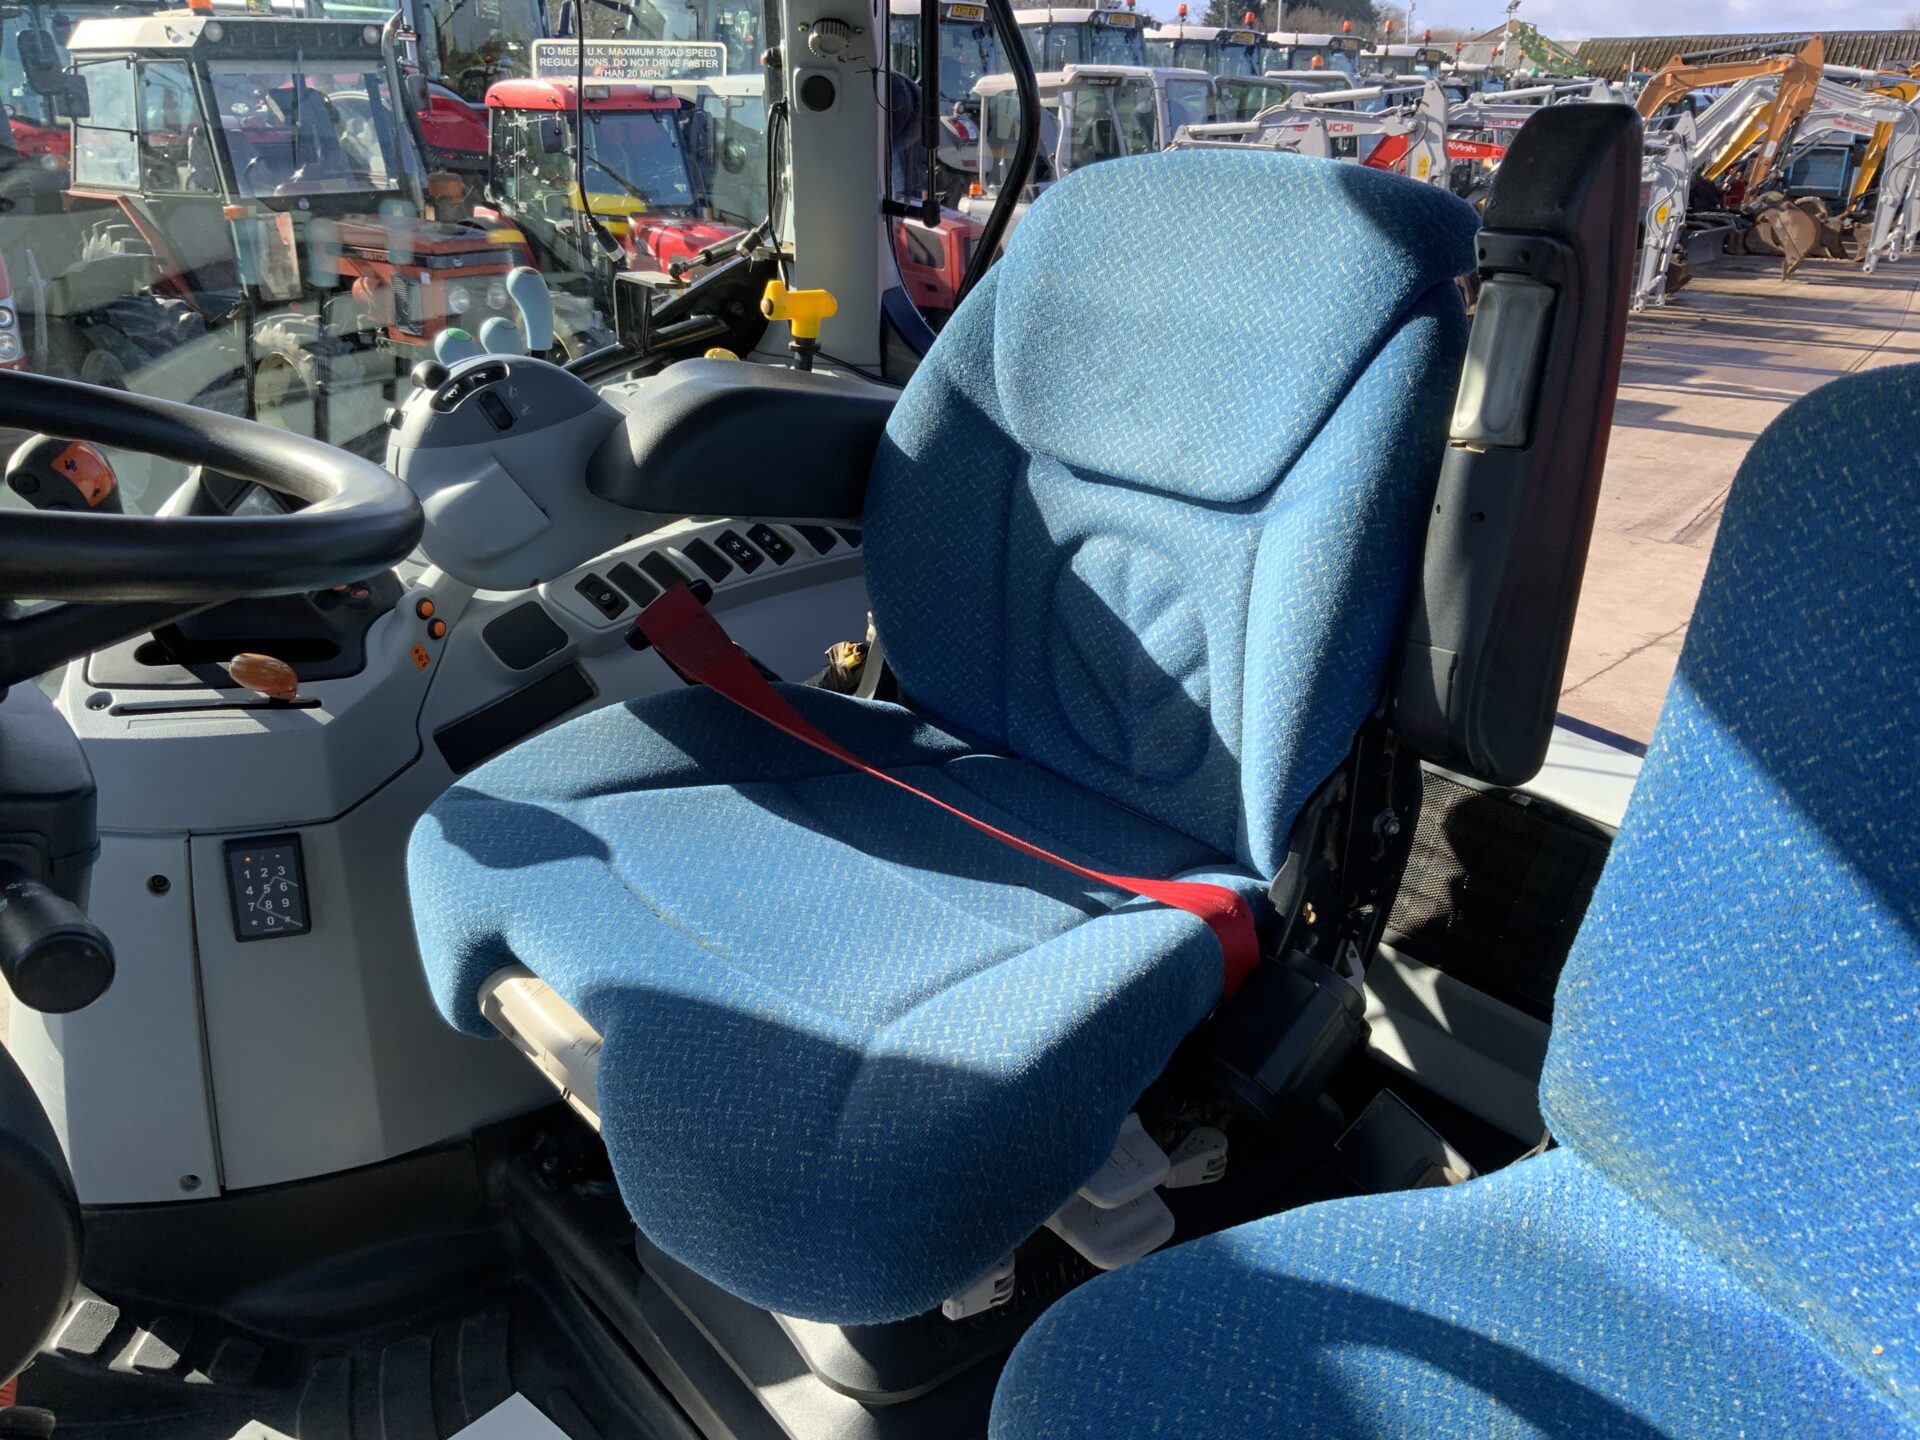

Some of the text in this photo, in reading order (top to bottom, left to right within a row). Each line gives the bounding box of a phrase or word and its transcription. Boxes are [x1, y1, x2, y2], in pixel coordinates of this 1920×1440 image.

[541, 46, 717, 58] TO MEE U.K. MAXIMUM ROAD SPEED
[539, 57, 719, 68] REGULAIONS, DO NOT DRIVE FASTER
[599, 68, 625, 78] THAN
[626, 68, 638, 78] 20
[1448, 142, 1477, 153] Kubota
[243, 866, 286, 879] 1 2 3
[245, 882, 288, 895] 4 5 6
[248, 898, 290, 912] 7 8 9
[267, 916, 275, 926] 0
